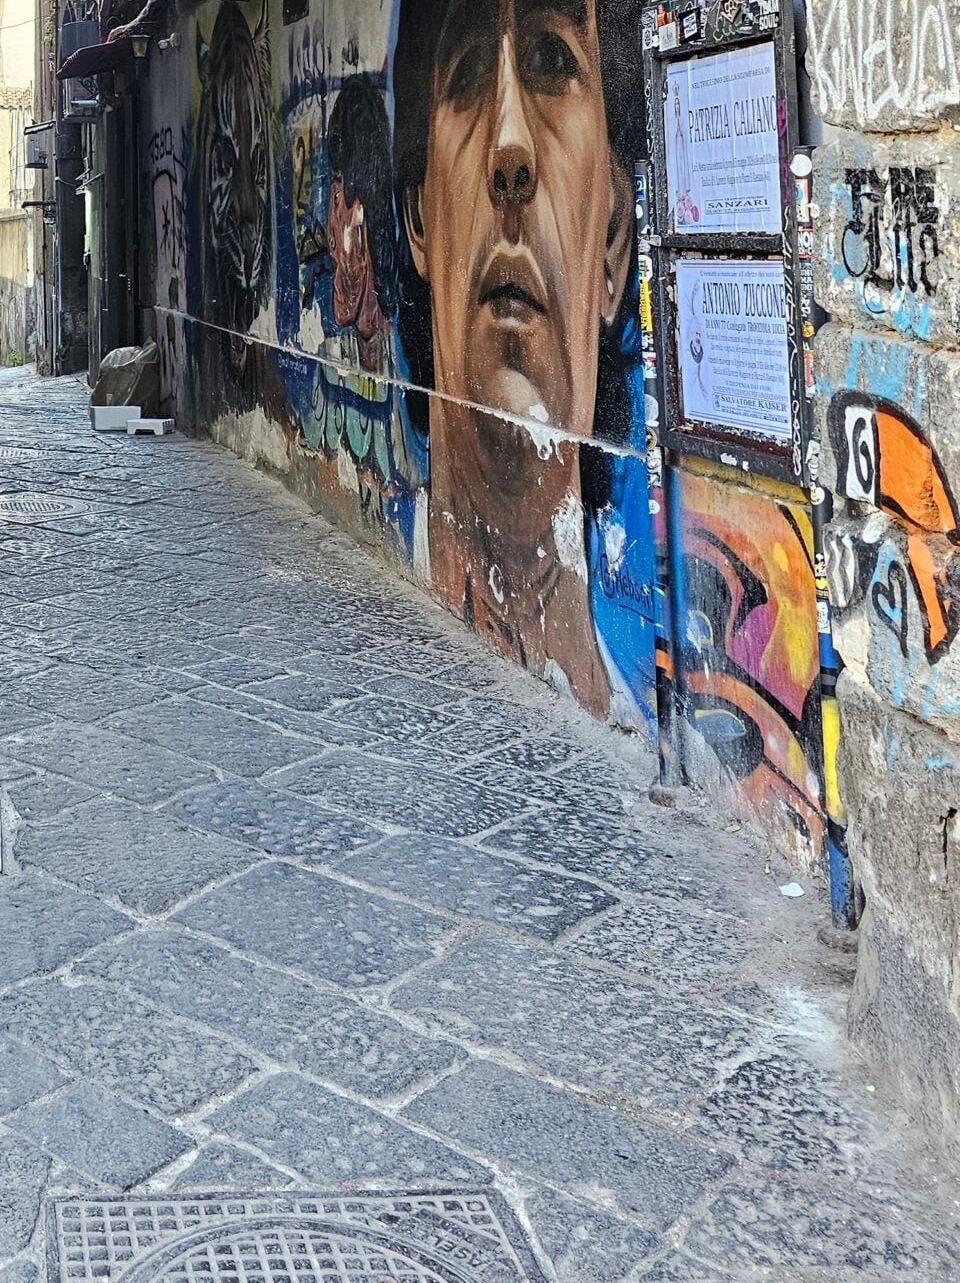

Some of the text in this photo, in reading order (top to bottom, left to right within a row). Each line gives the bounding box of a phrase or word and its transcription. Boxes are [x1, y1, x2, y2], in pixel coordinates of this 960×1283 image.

[688, 102, 732, 144] PATRIZIA
[707, 198, 769, 209] SANZARI
[702, 282, 786, 319] ANTONIO ZUCCONE
[721, 394, 788, 413] SALVATORE KAISER
